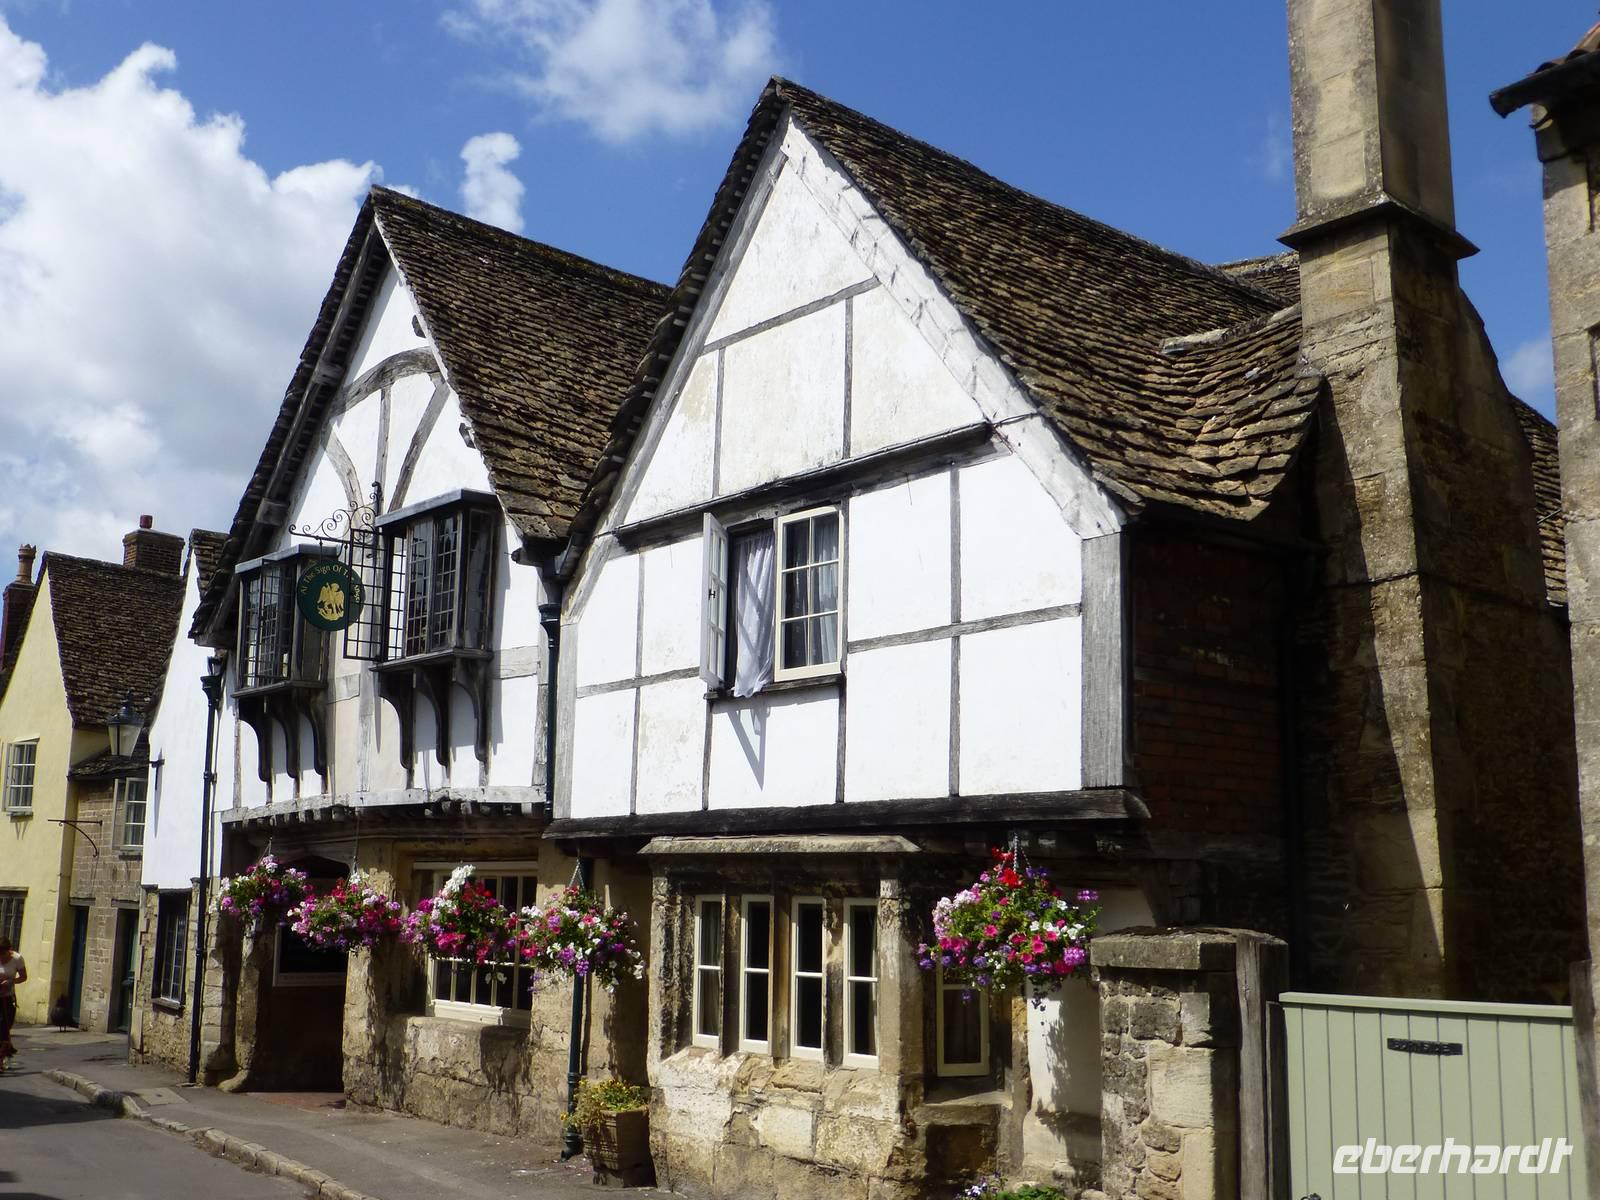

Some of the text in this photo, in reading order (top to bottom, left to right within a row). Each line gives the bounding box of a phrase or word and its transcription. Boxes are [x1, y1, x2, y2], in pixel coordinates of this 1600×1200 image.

[303, 572, 315, 584] The
[315, 564, 331, 575] Sign
[332, 564, 343, 573] Of
